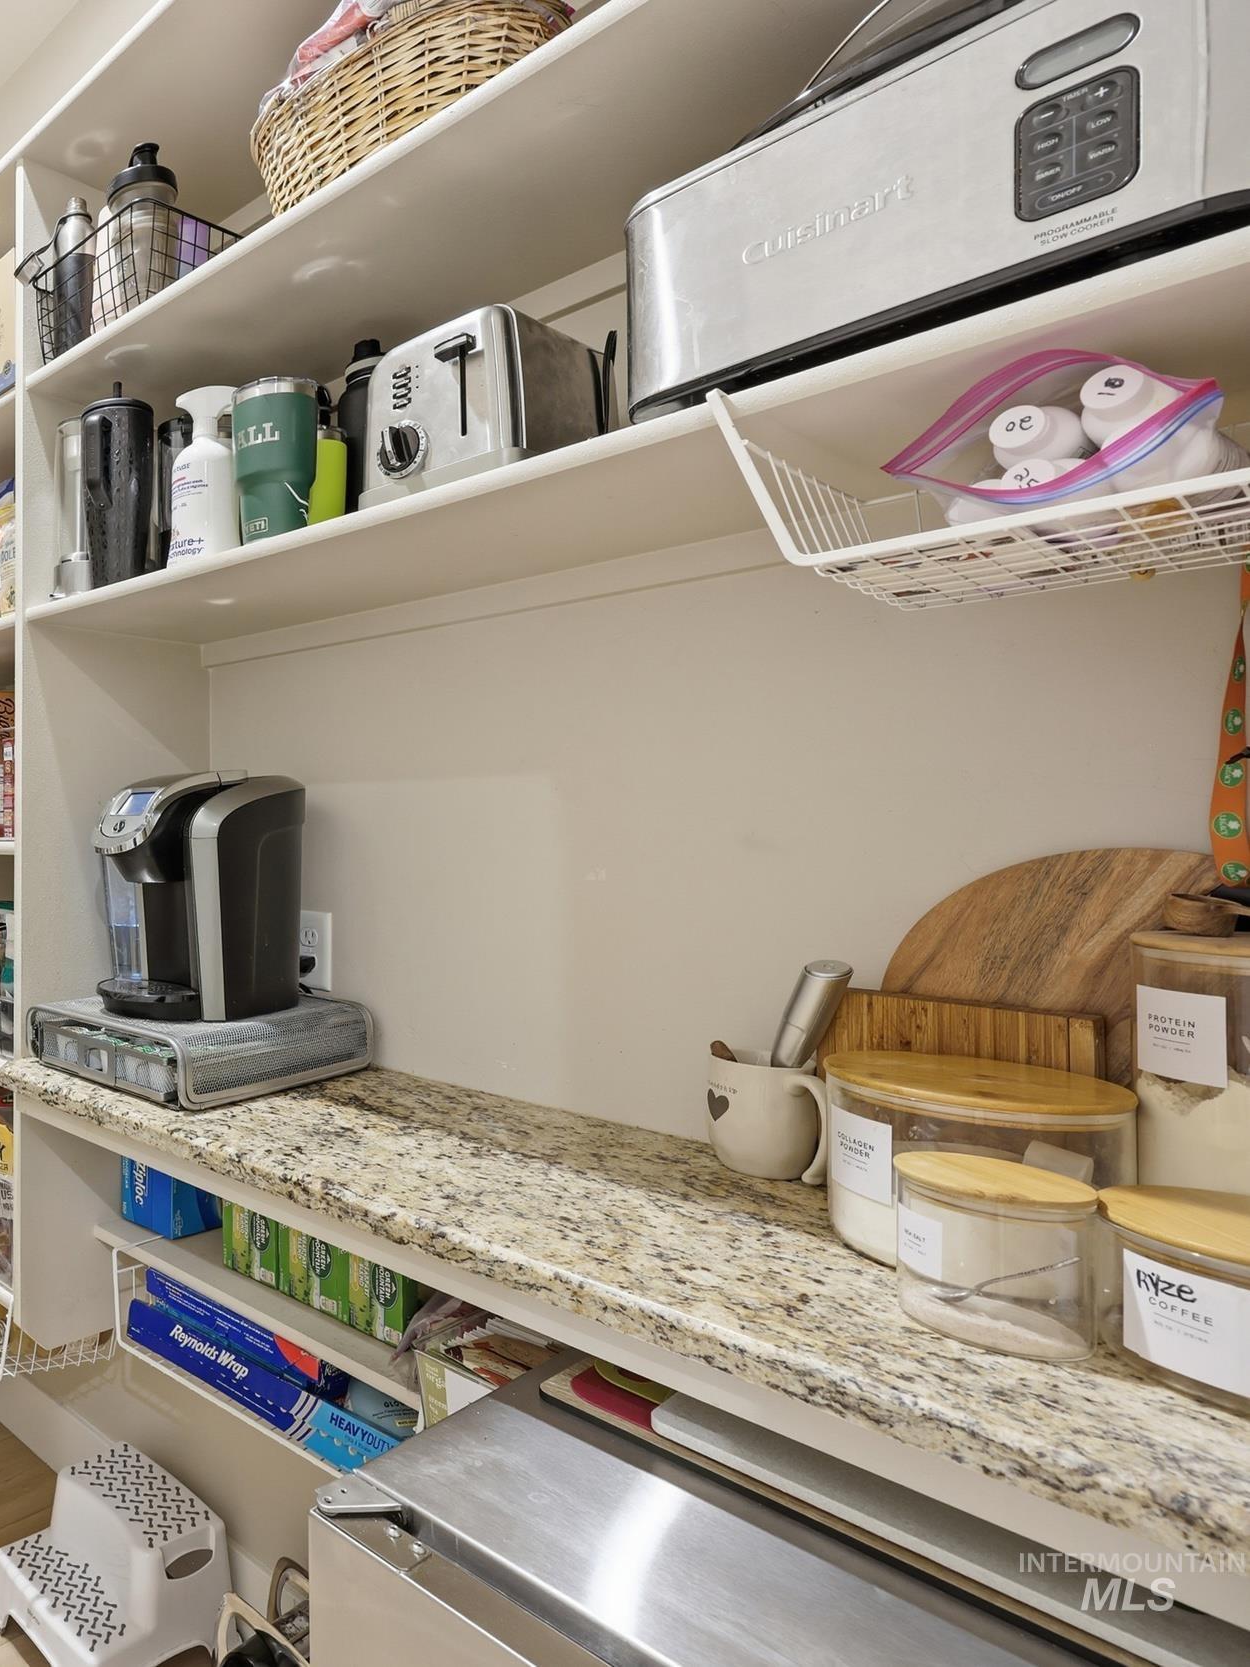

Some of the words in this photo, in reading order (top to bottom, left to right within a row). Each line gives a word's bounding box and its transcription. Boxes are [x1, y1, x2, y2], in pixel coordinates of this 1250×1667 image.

[1090, 115, 1113, 128] LOW
[1037, 136, 1059, 150] HIGH
[741, 174, 914, 265] Cuisinart
[1034, 206, 1118, 240] PROGRAMMABLE
[1040, 230, 1069, 246] SLOW
[1070, 216, 1115, 239] COOKER
[245, 519, 267, 534] YETI
[1147, 1012, 1196, 1028] PROTEIN
[1148, 1023, 1196, 1039] POWDER
[837, 1130, 875, 1152] COLLAGEN
[839, 1140, 871, 1159] POWDER
[134, 1161, 148, 1206] Ziploc
[319, 1243, 328, 1271] GREEN
[383, 1270, 391, 1299] GREEN
[1148, 1296, 1214, 1327] COFFEE
[169, 1324, 219, 1361] Reynolds
[217, 1349, 250, 1380] Wrap
[329, 1412, 368, 1441] HEAVY
